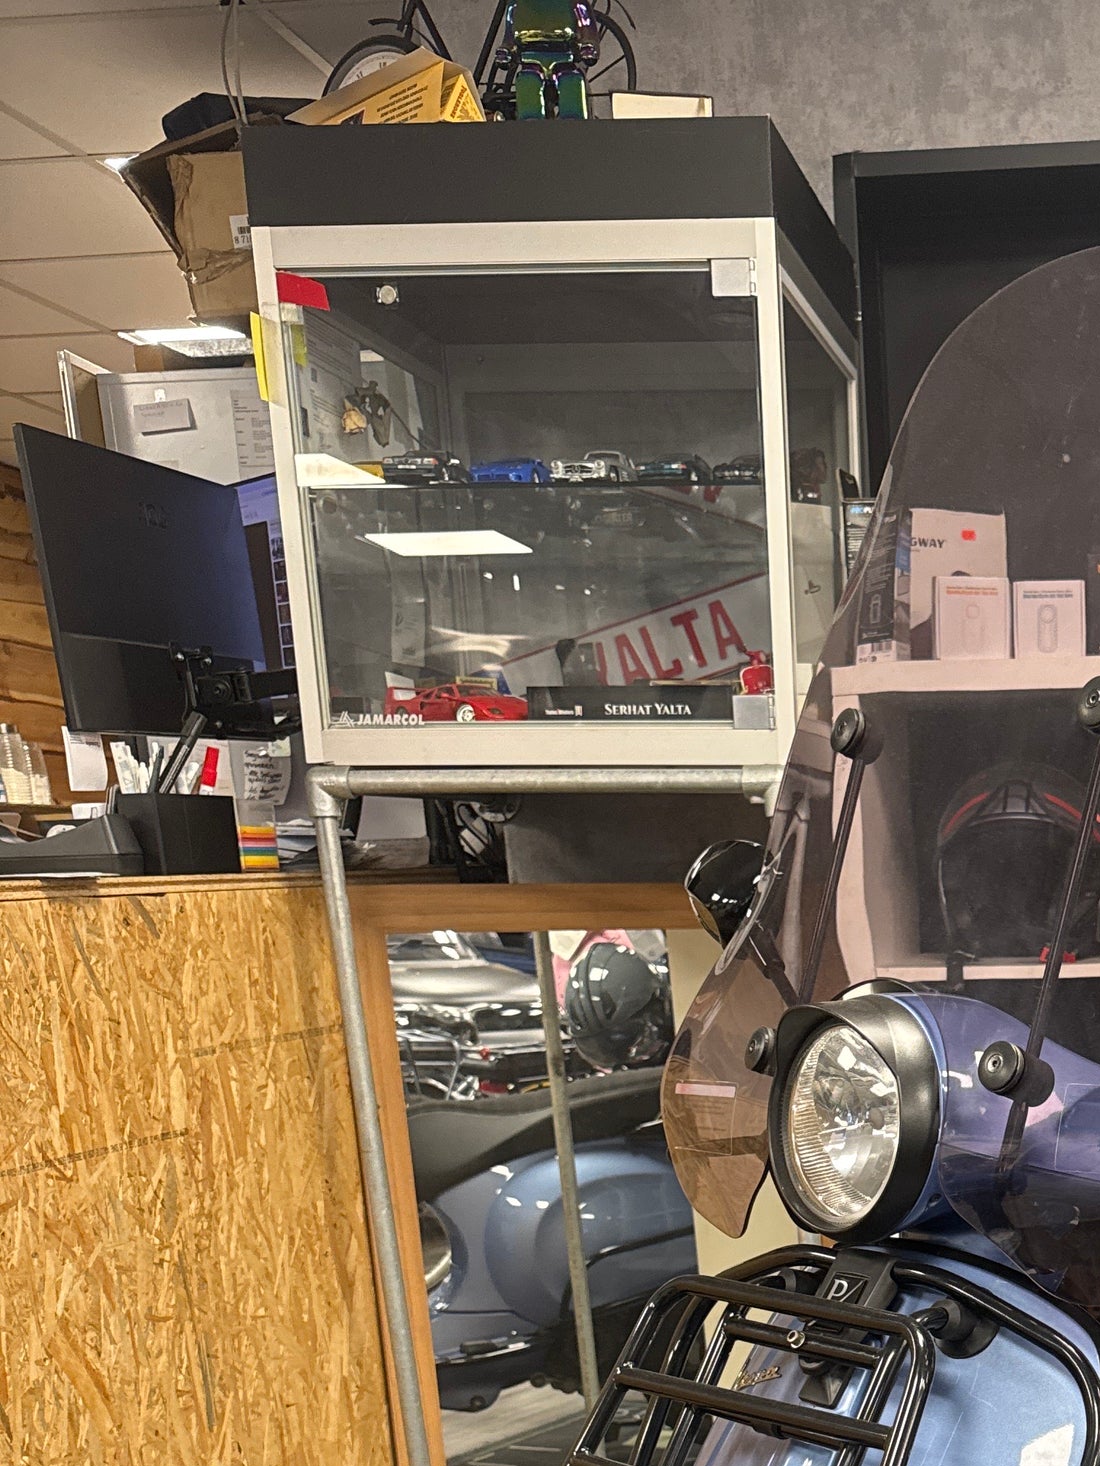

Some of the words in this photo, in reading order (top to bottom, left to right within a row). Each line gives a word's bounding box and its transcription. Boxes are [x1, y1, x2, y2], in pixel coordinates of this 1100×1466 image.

[604, 703, 652, 716] SERHAT
[655, 703, 692, 715] YALTA
[357, 713, 425, 726] JAMARCOL
